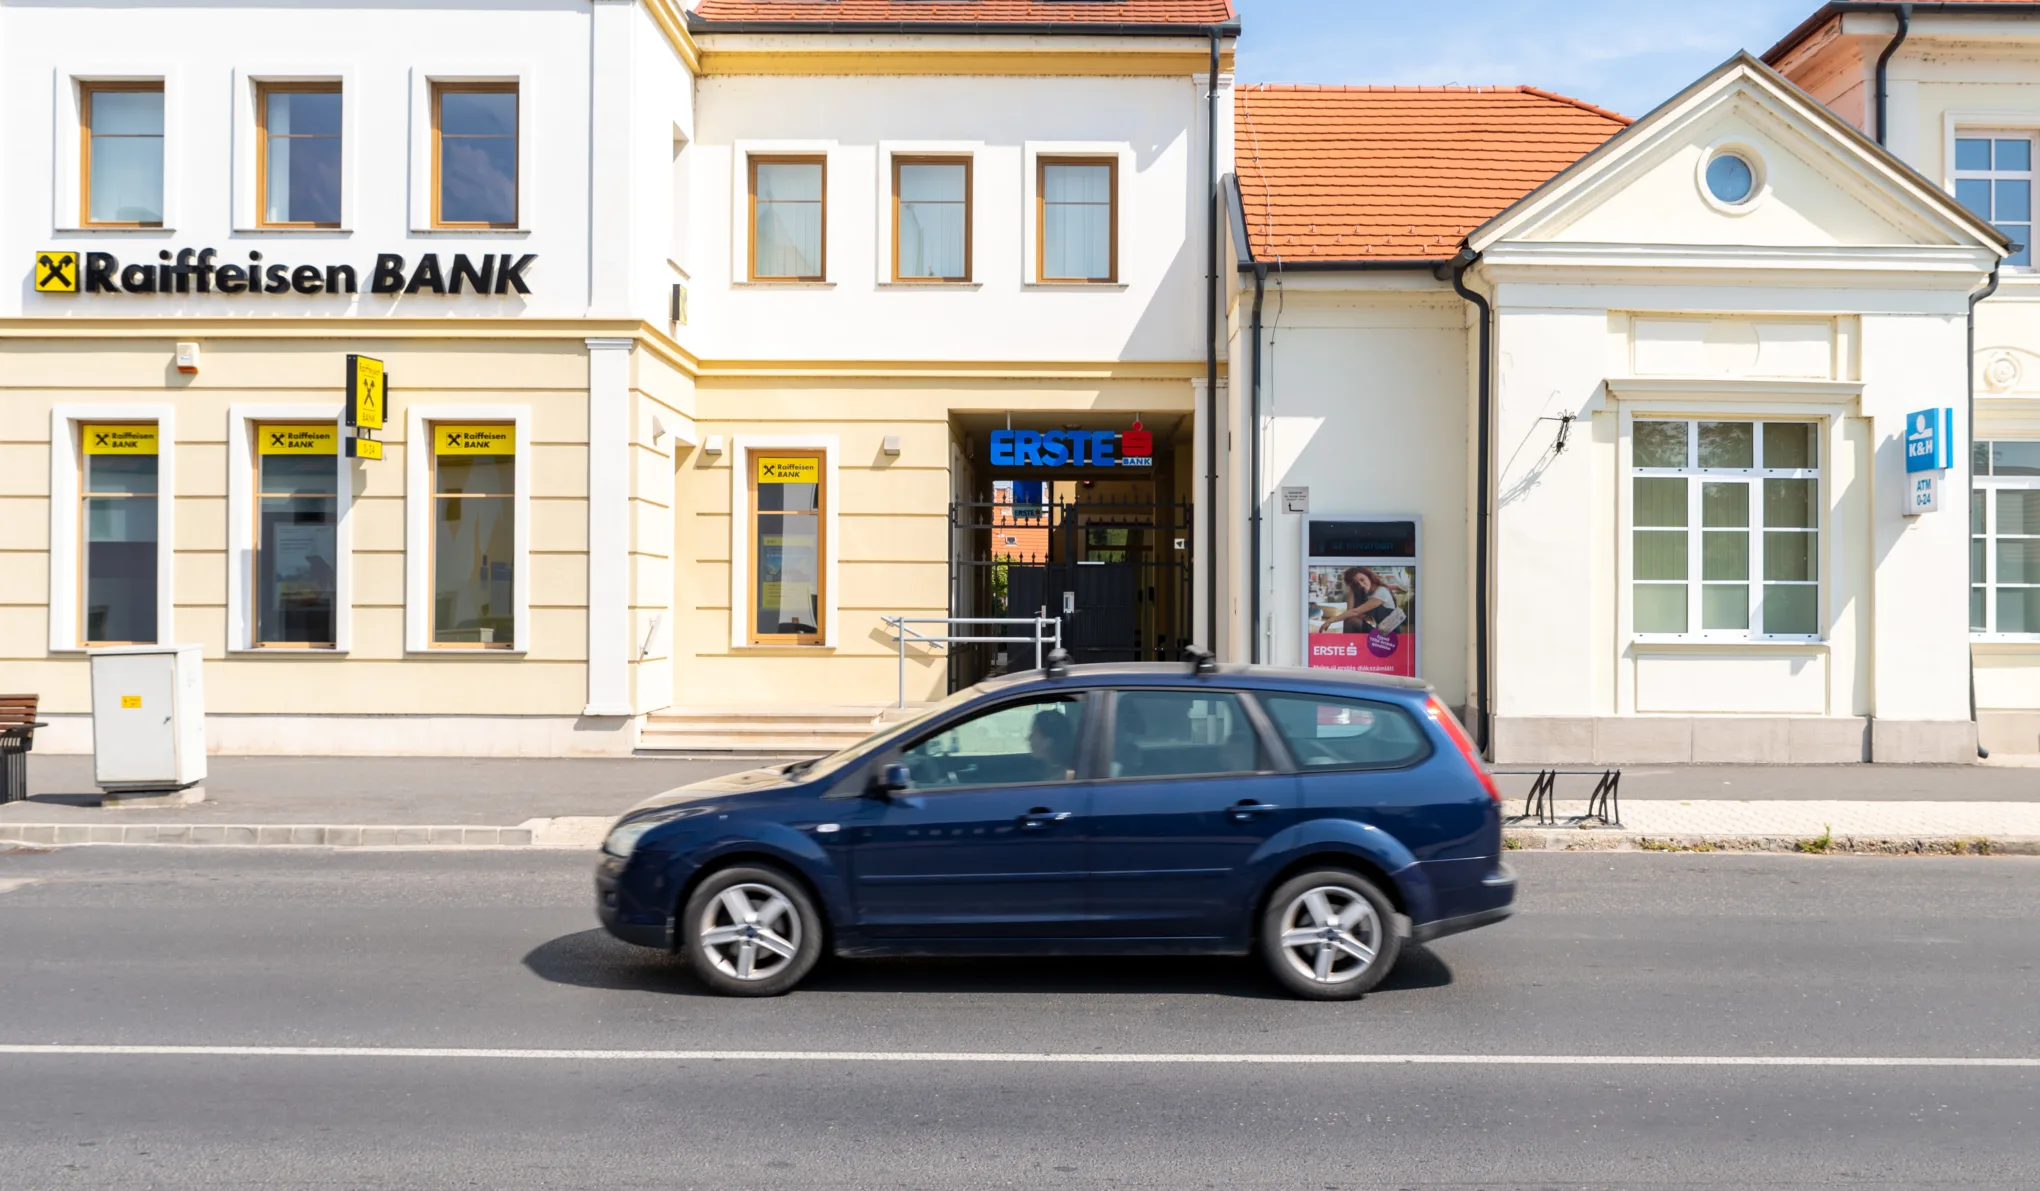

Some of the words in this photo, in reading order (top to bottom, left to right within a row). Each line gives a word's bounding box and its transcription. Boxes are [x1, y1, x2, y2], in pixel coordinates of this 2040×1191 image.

[86, 247, 358, 294] Raiffeisen
[371, 253, 539, 294] BANK
[990, 429, 1115, 467] ERSTE
[1909, 439, 1933, 457] K&H
[1123, 457, 1152, 465] BANK
[1916, 478, 1931, 491] ATM
[1916, 493, 1931, 506] 0-24
[1313, 645, 1345, 656] ERSTE
